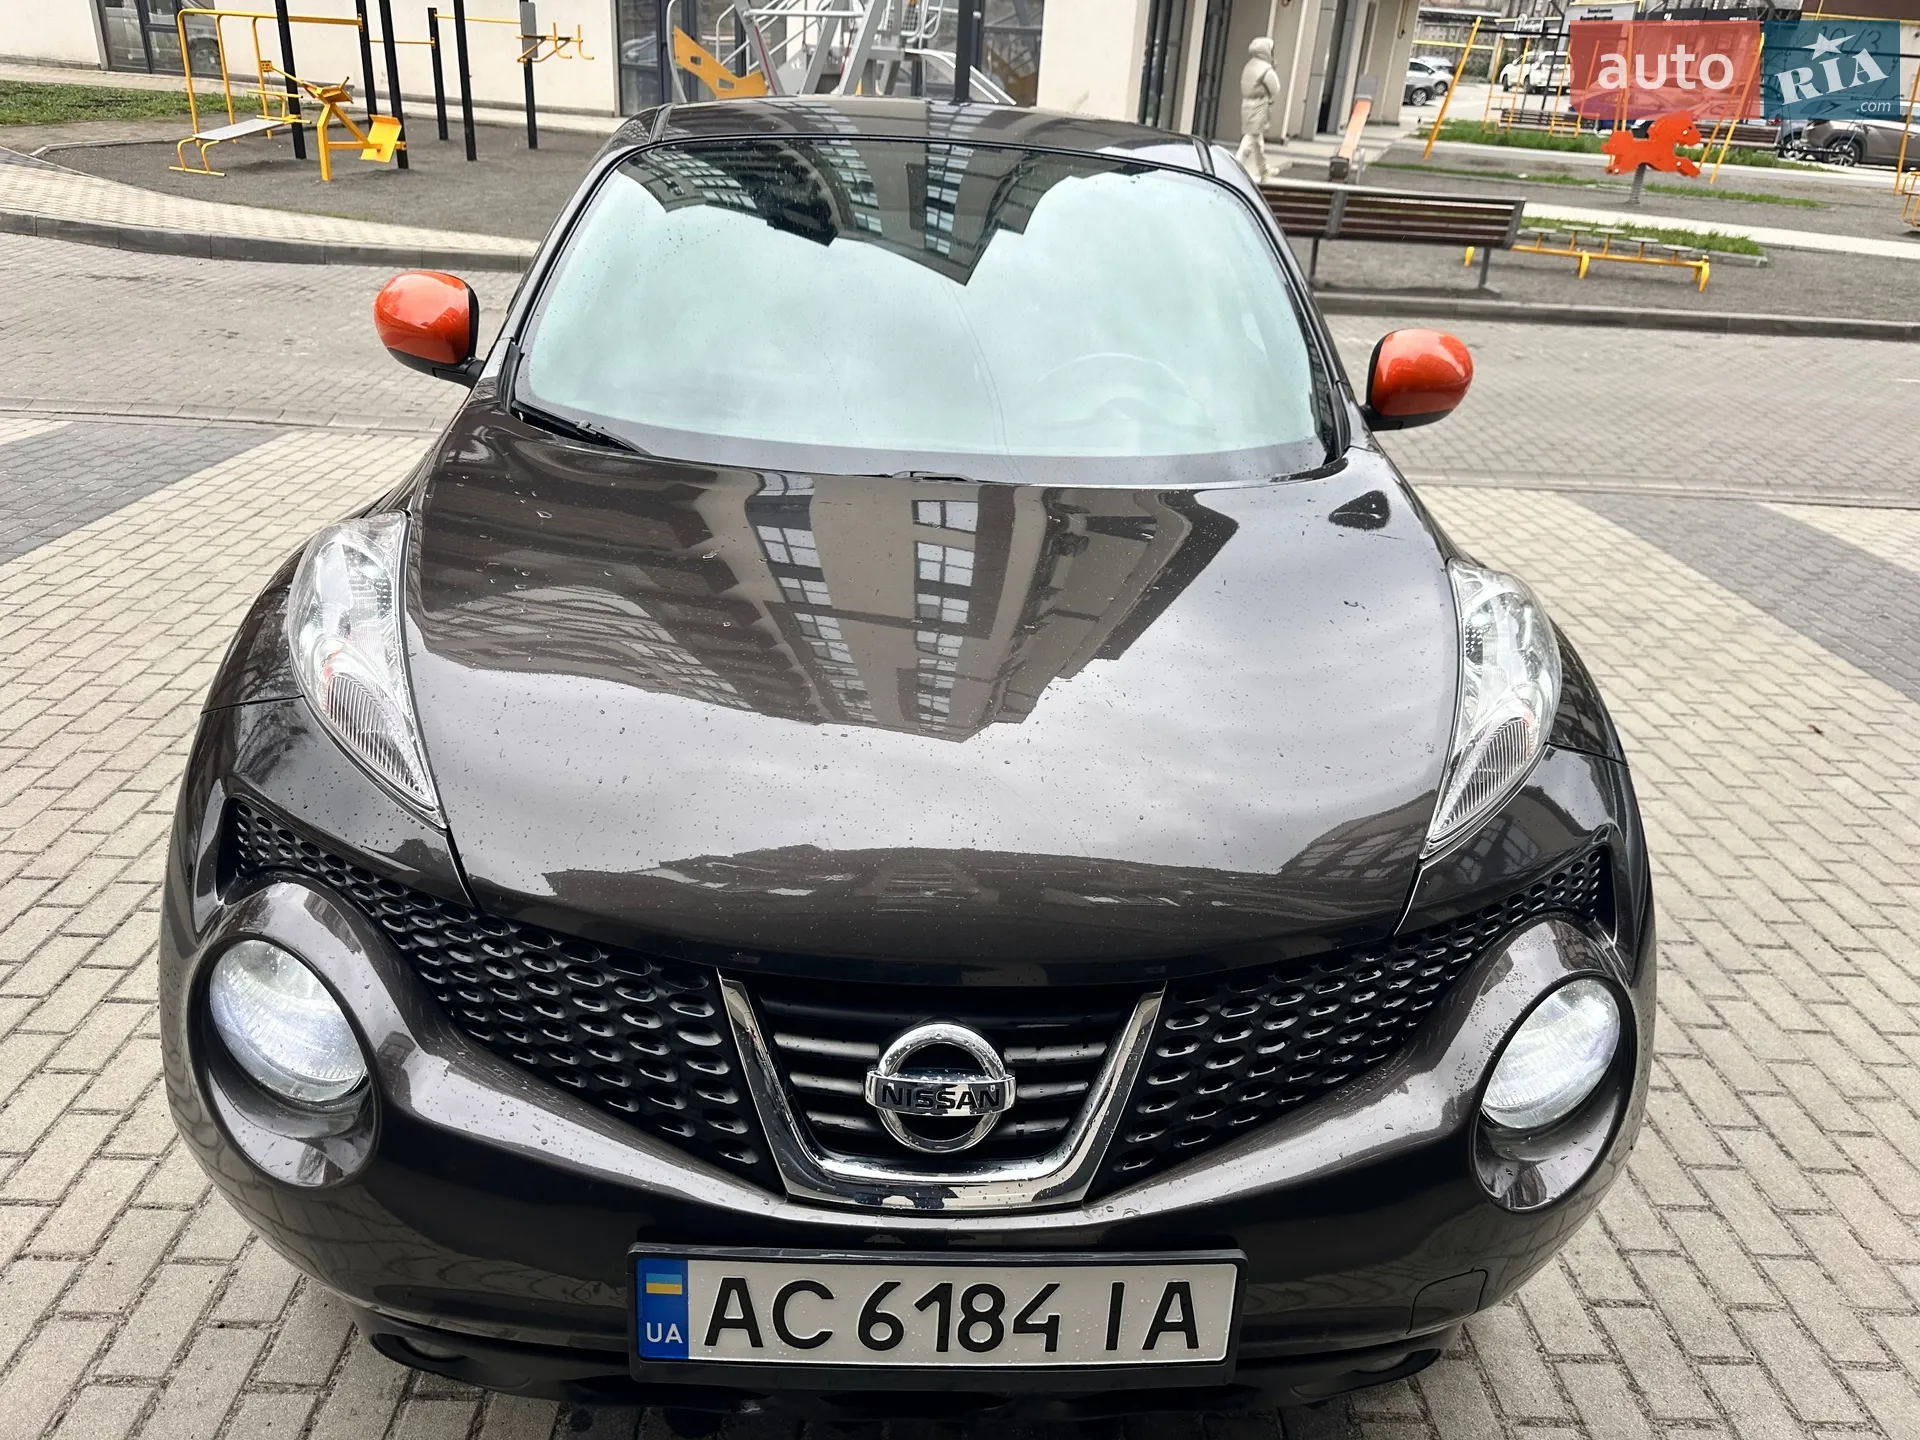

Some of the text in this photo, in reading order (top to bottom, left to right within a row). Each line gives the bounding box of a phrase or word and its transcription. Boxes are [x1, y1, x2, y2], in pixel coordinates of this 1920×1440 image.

[881, 1084, 1000, 1111] NISSAN
[703, 1276, 1200, 1353] AC 6184 IA
[646, 1322, 684, 1344] UA
